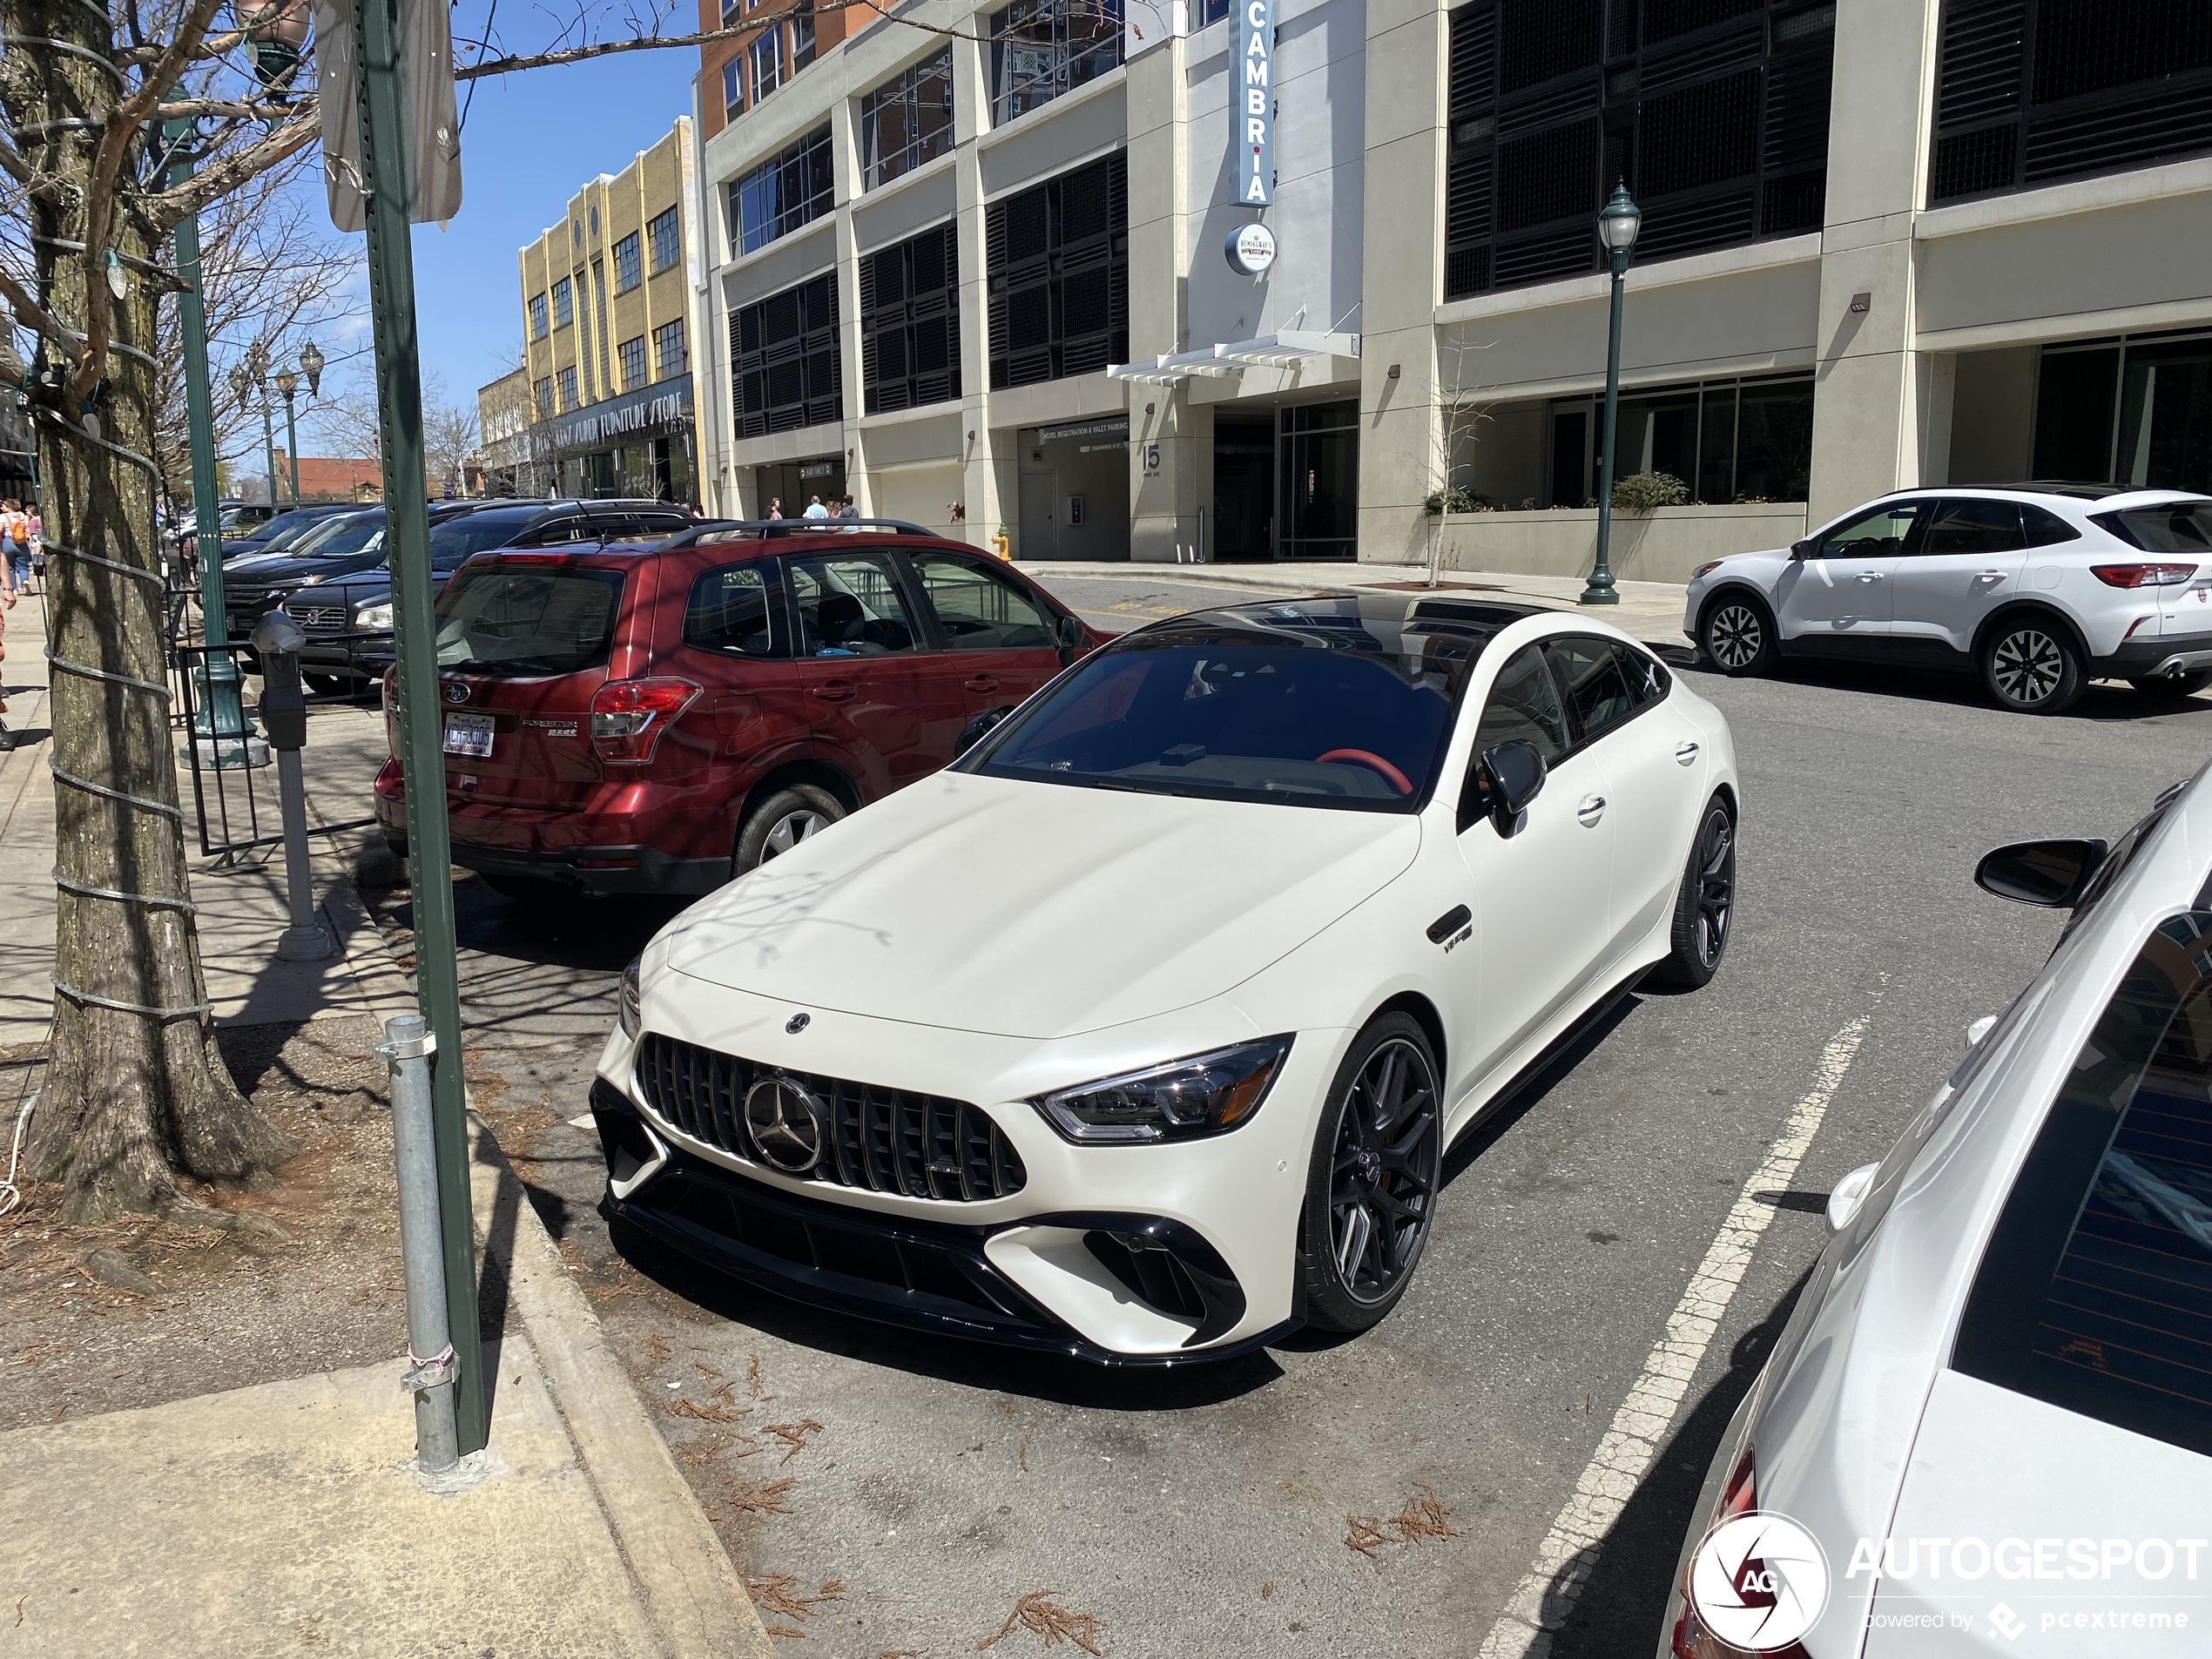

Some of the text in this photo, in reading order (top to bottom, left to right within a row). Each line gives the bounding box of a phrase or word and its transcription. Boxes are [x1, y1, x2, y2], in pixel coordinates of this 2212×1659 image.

[1246, 1, 1268, 201] CAMBRIA
[1241, 239, 1272, 249] HEMINGWAY'S
[575, 417, 597, 444] SUPER
[600, 402, 647, 442] FURNITURE
[651, 391, 682, 425] STORE
[1057, 428, 1088, 438] REGISTRATION
[1107, 422, 1128, 431] PARKING
[1143, 444, 1160, 469] 15
[522, 719, 578, 728] FORESTER
[446, 723, 490, 745] KCH-3305
[448, 743, 486, 753] NORTH CAROLINA
